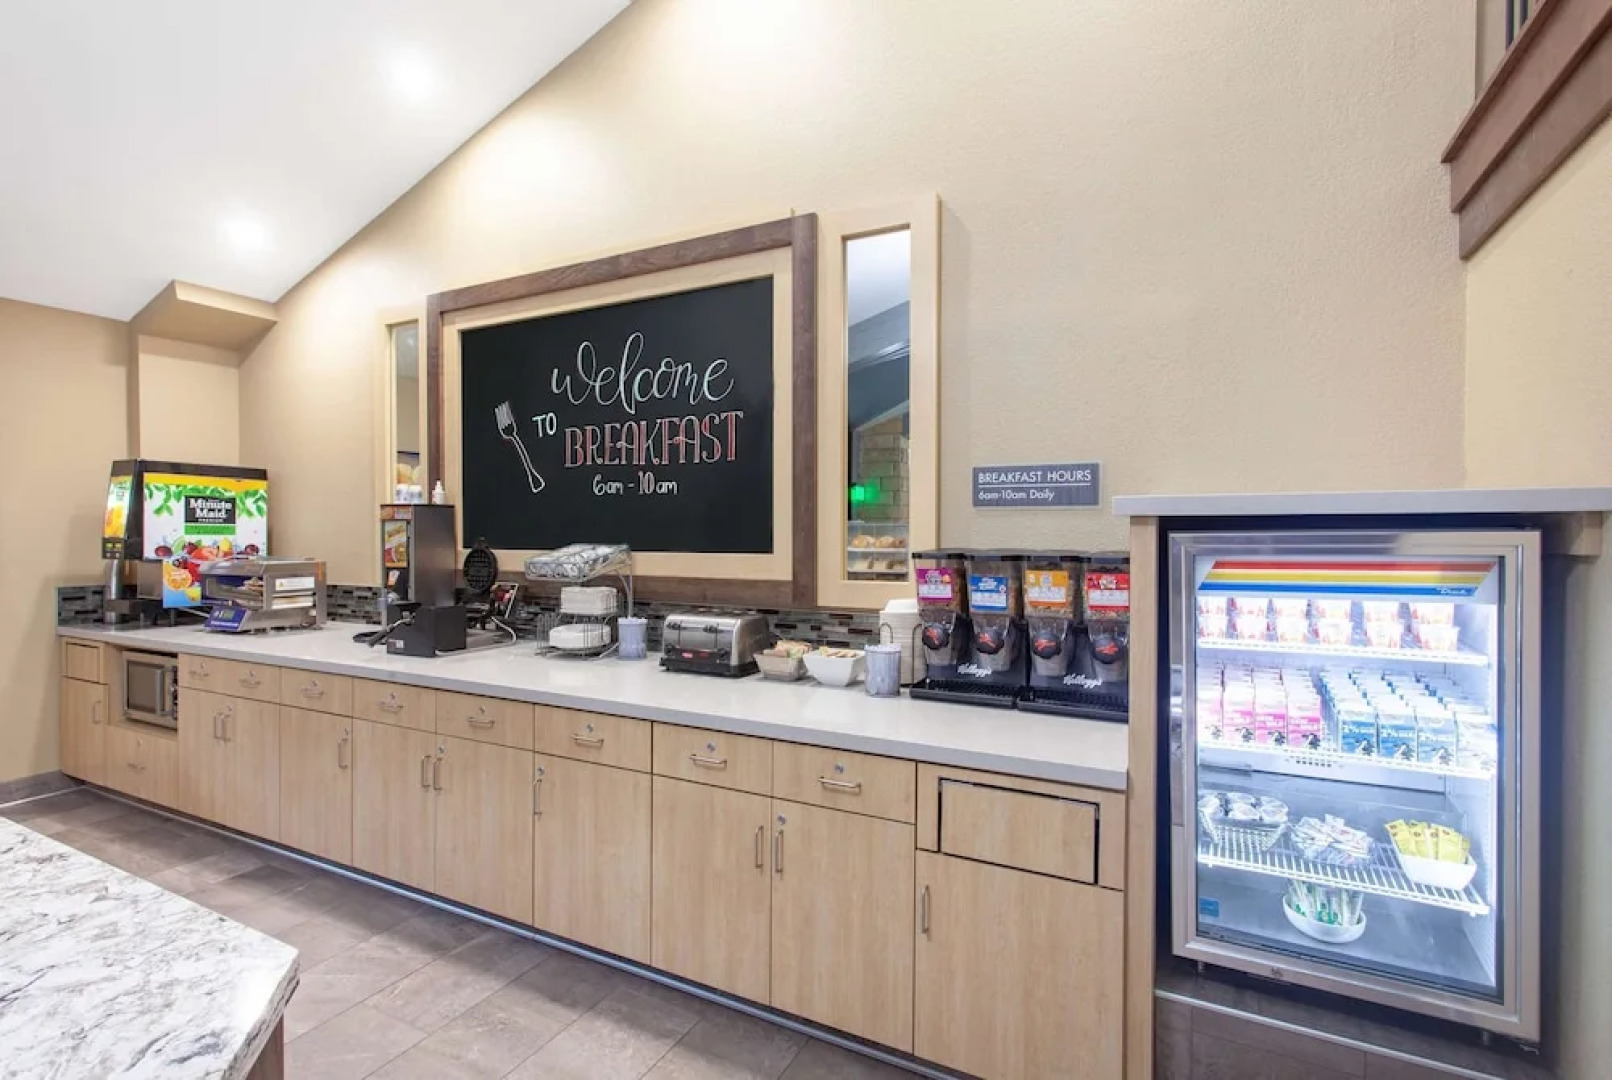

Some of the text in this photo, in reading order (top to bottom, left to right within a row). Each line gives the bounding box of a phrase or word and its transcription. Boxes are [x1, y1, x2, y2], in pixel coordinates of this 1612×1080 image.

[551, 331, 735, 414] Welcome
[532, 410, 744, 468] TO BREAKFAST
[592, 473, 624, 496] 6am
[637, 470, 678, 496] 10am
[977, 470, 1091, 484] BREAKFAST HOURS
[978, 489, 1055, 501] 6am-10am Daily
[189, 498, 232, 509] Minute
[195, 508, 227, 518] Maid
